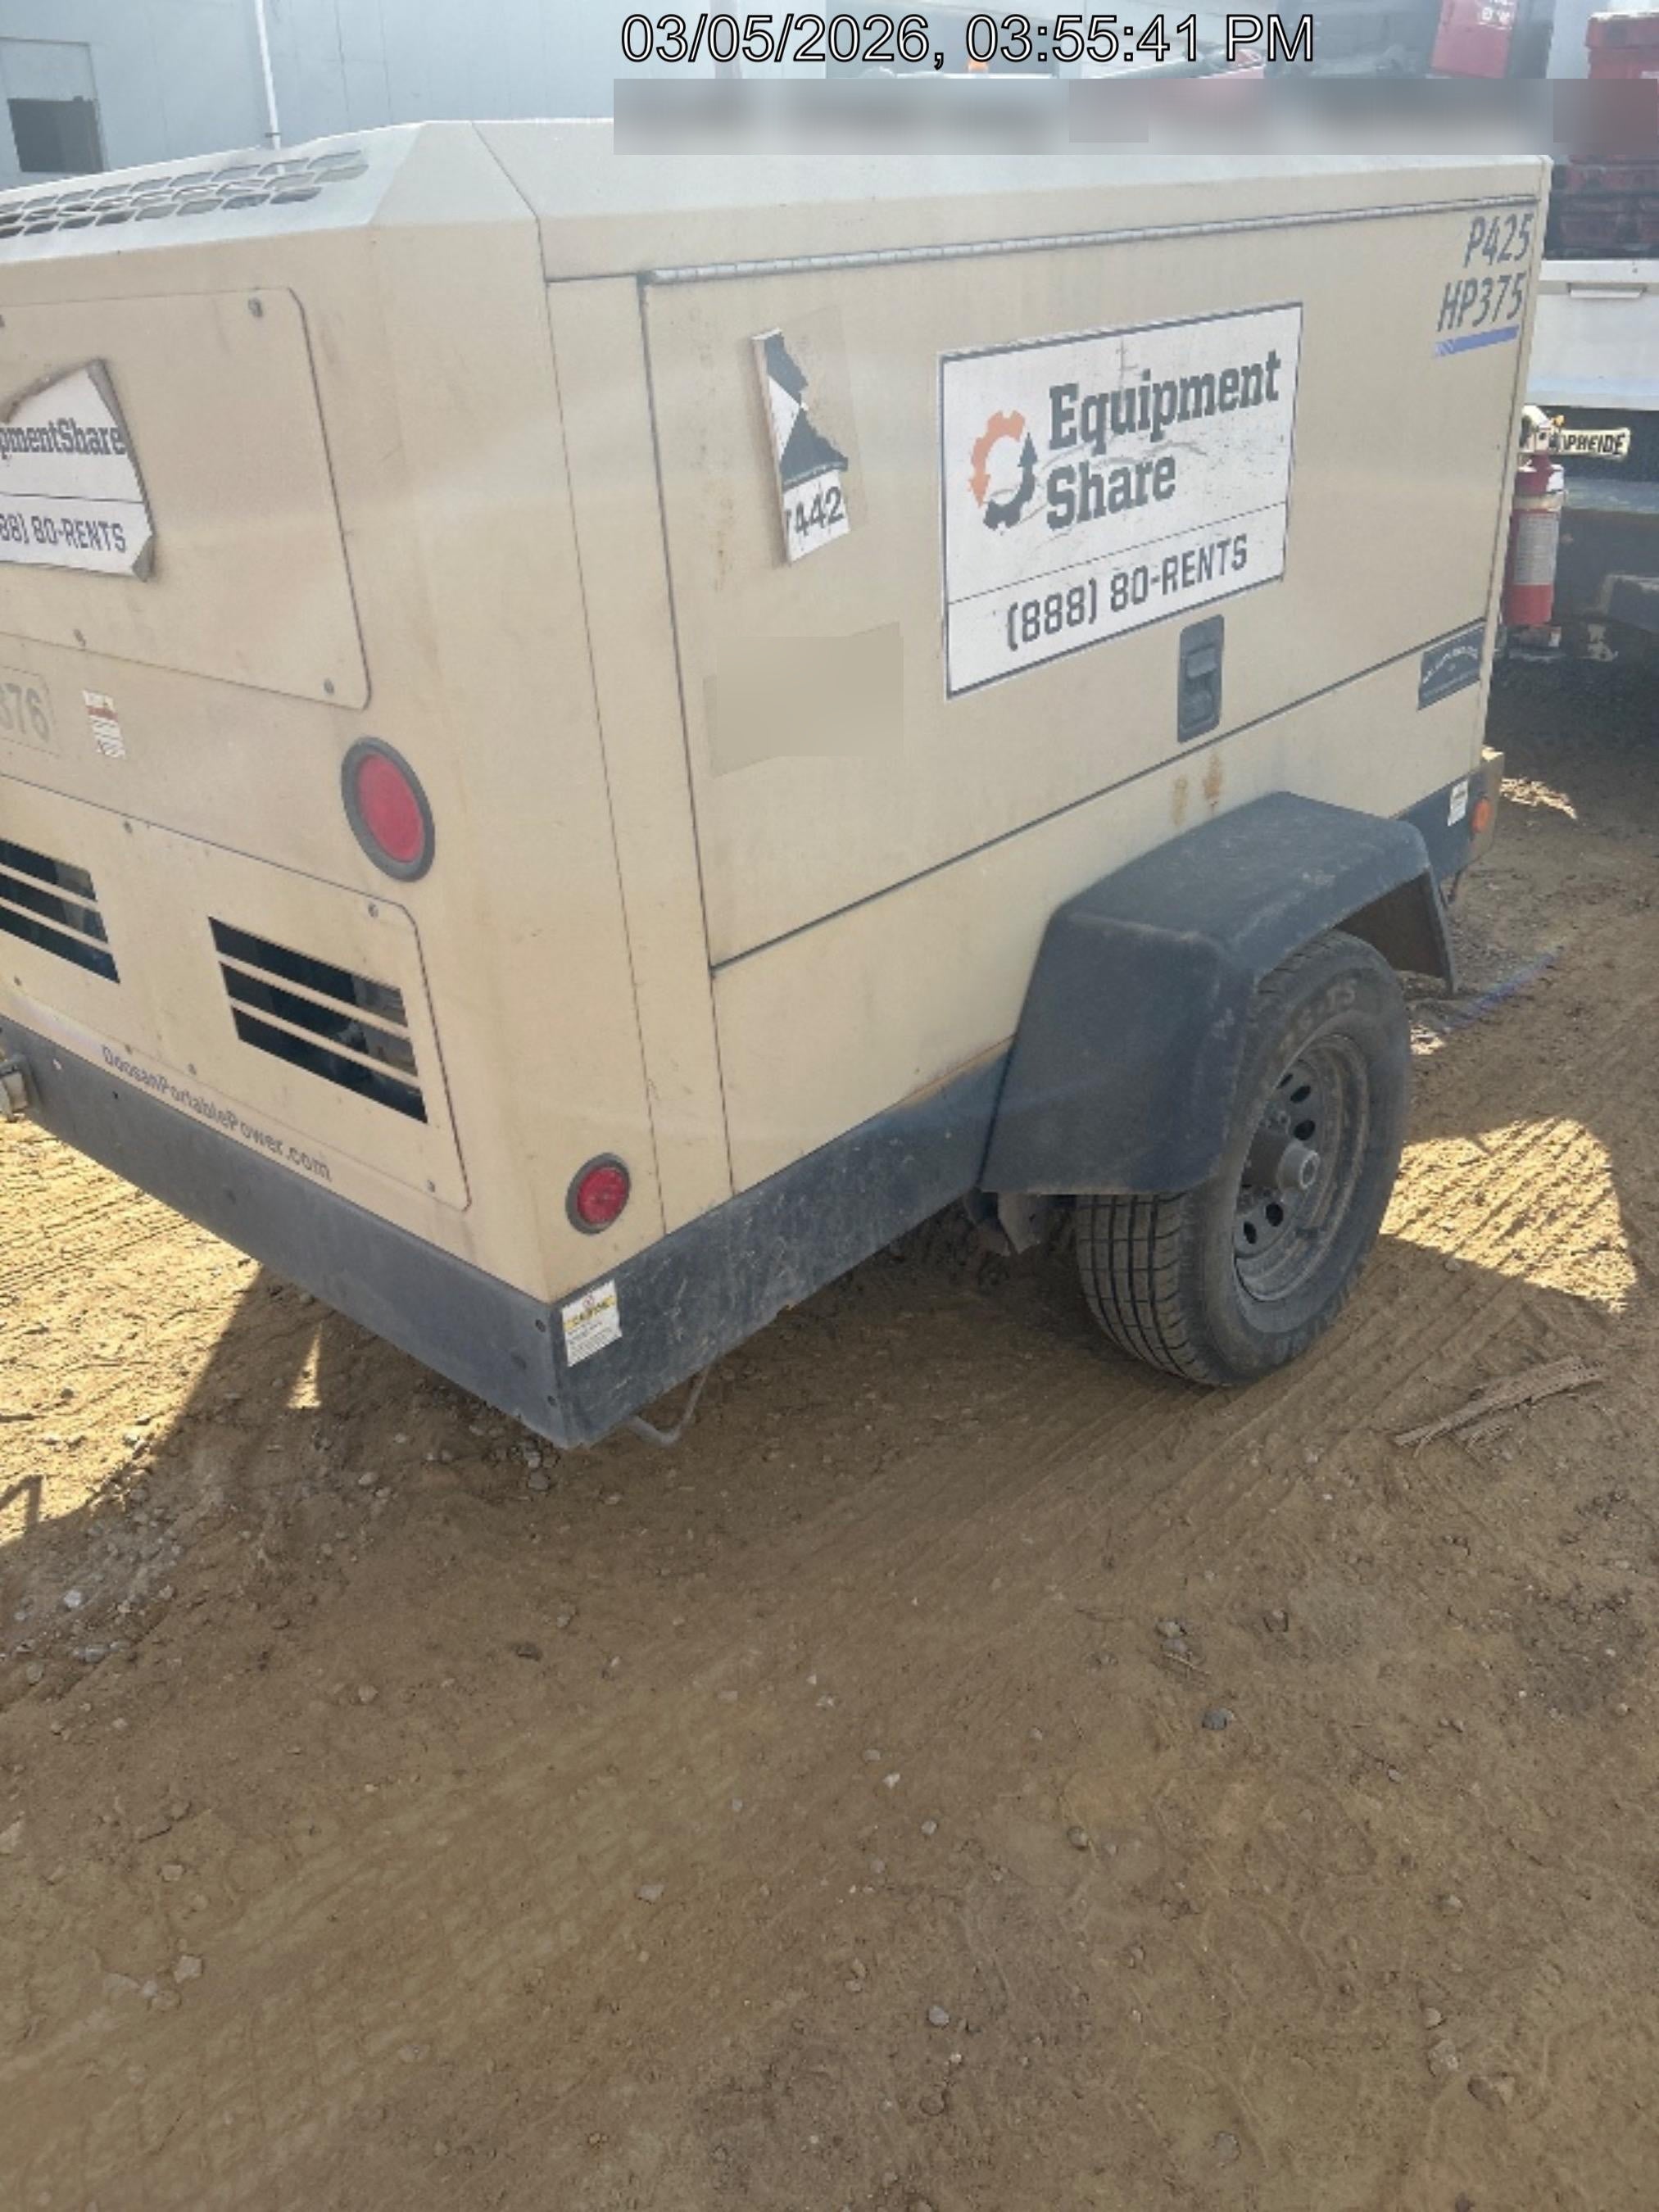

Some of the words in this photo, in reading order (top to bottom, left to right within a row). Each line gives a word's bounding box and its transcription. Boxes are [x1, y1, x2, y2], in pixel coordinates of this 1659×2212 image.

[1463, 213, 1534, 268] P425
[1438, 272, 1526, 332] HP375
[1049, 350, 1281, 455] Equipment
[1046, 455, 1176, 531] Share
[31, 515, 126, 553] 80-RENTS
[1006, 578, 1098, 651] (888)
[1109, 534, 1248, 612] 80-RENTS
